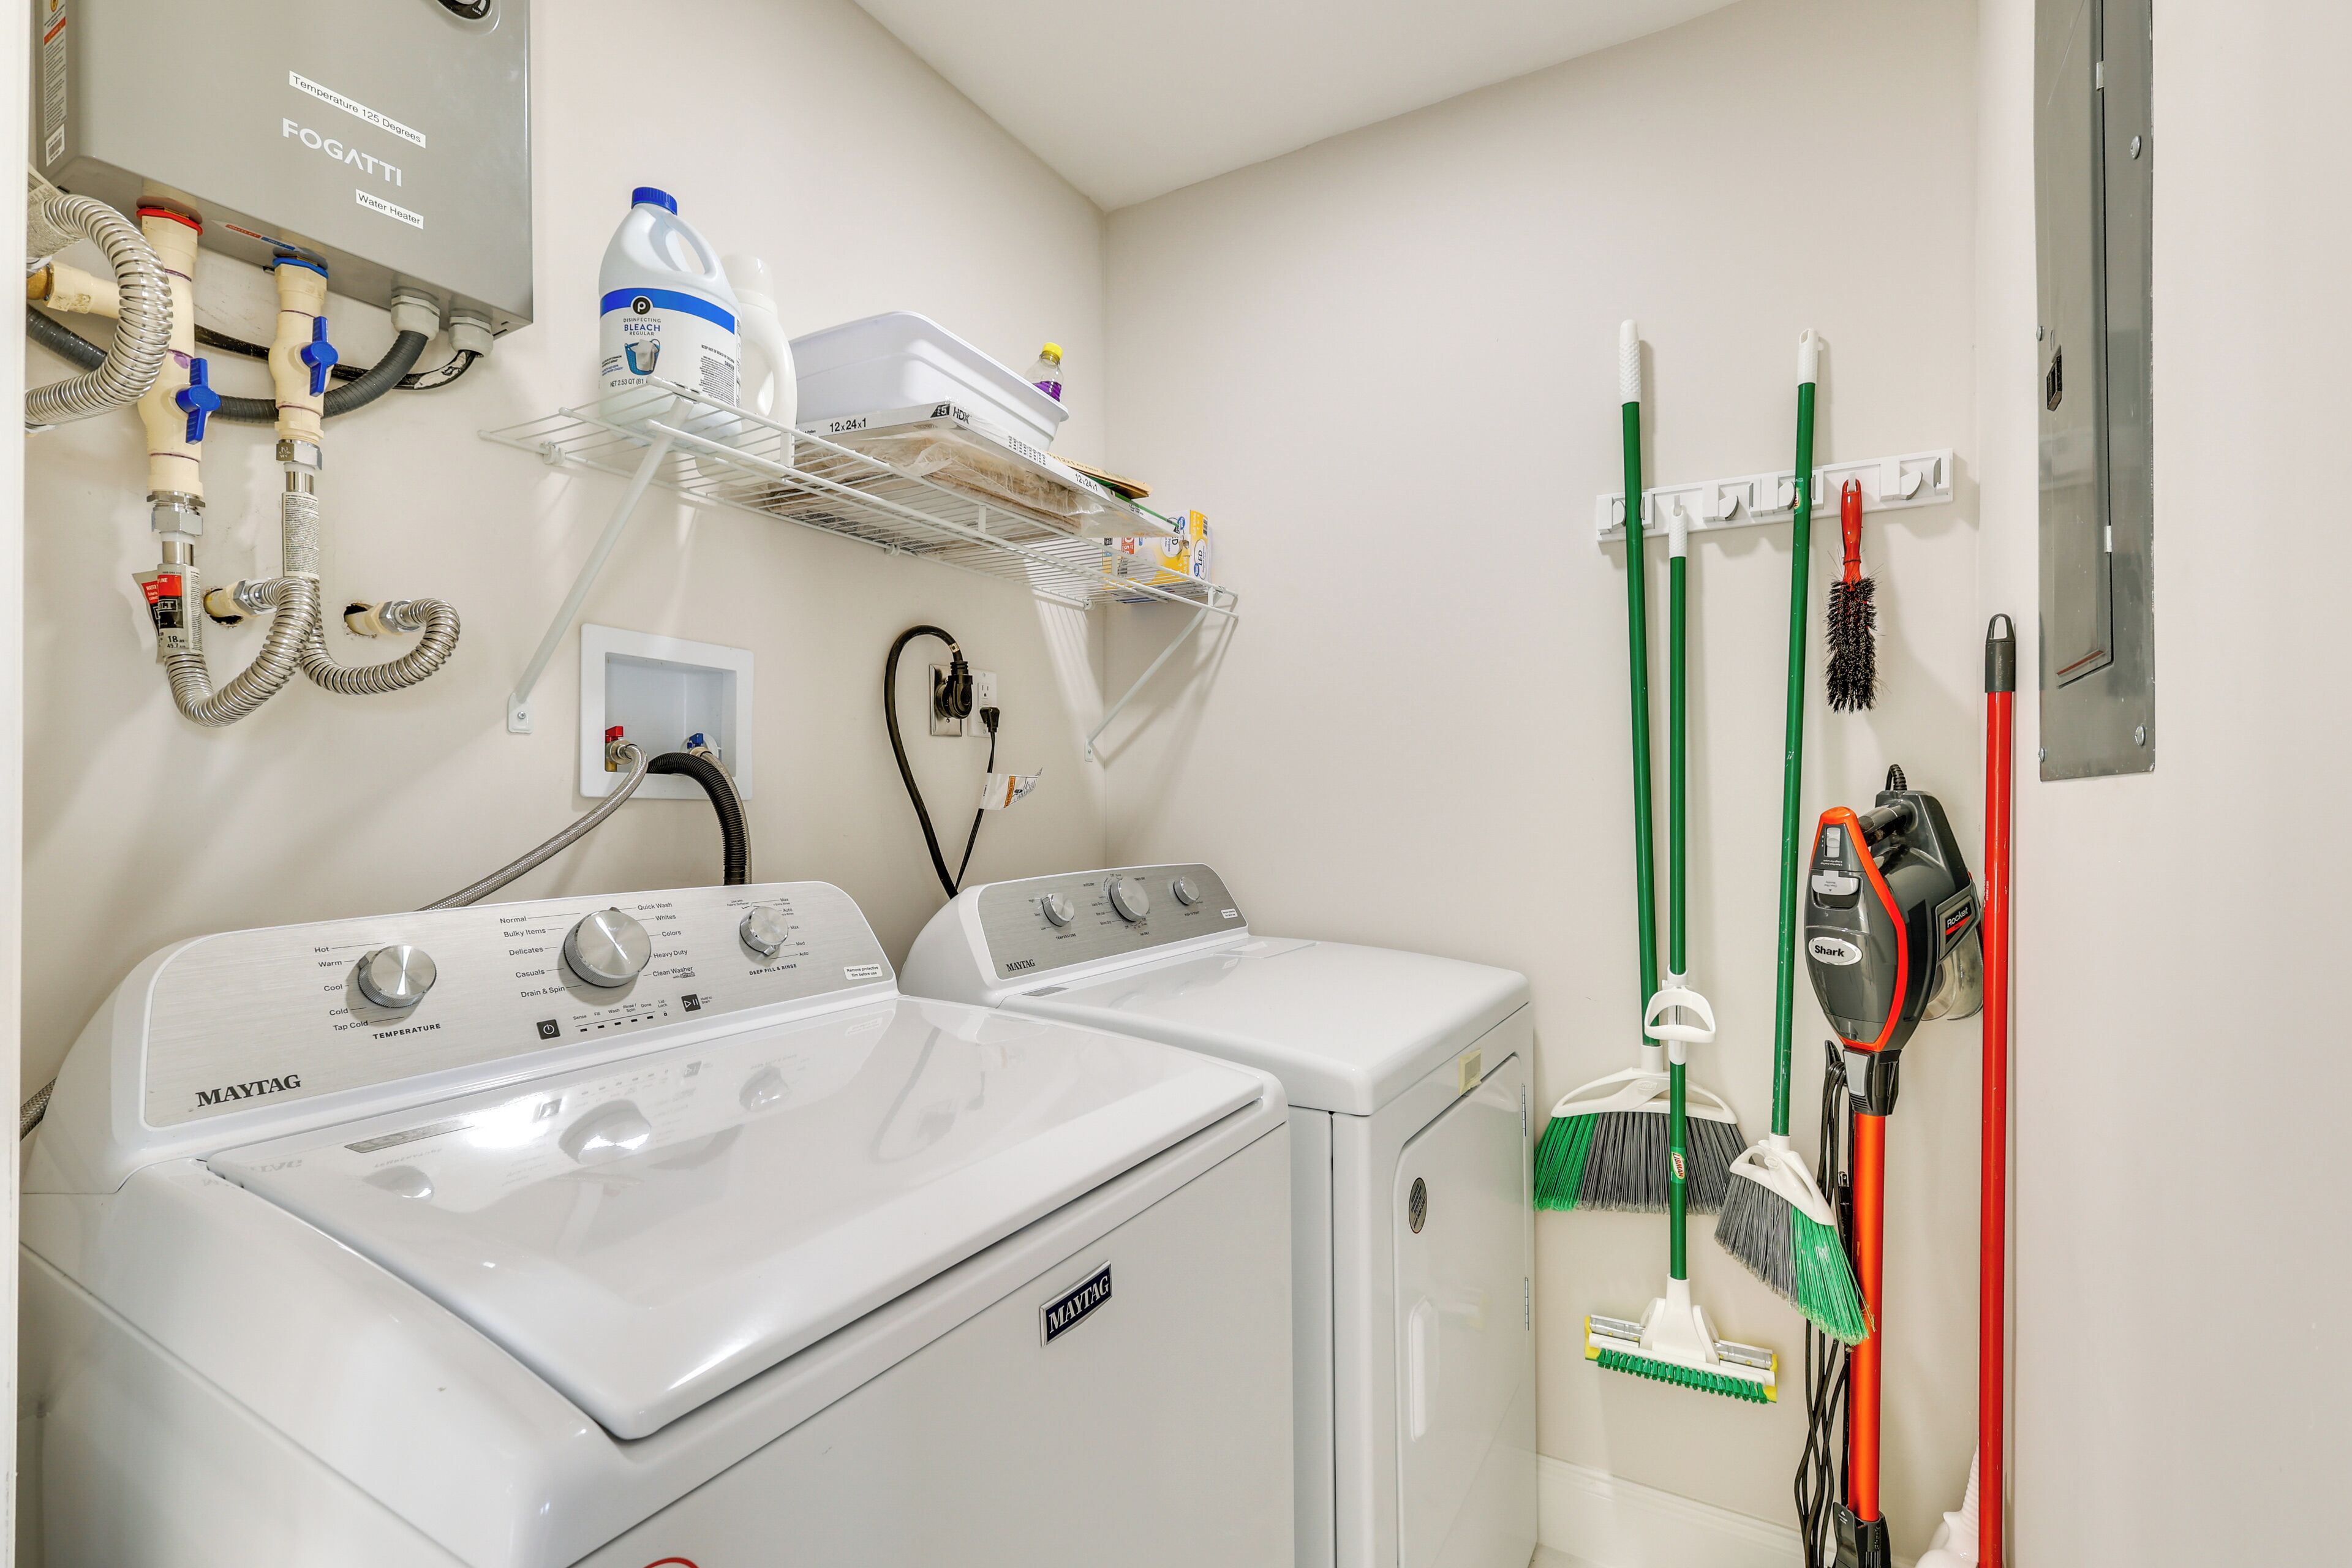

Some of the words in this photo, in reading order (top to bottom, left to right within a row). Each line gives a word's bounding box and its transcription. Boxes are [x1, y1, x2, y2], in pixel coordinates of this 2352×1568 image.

[293, 75, 358, 113] Temperature
[363, 109, 380, 123] 125
[383, 118, 421, 143] Degrees
[282, 118, 402, 187] FOGATTI
[358, 193, 386, 211] Water
[390, 206, 420, 224] Heater
[953, 406, 970, 424] HDX
[829, 418, 867, 432] 12x24x1
[1075, 473, 1098, 492] 12x24x1
[1947, 907, 1969, 928] Rocket
[509, 947, 544, 956] Delicates
[1814, 944, 1845, 958] Shark
[516, 970, 545, 978] Casuals
[1006, 959, 1036, 972] MAYTAG
[372, 1023, 441, 1039] TEMPERATURE
[195, 1074, 301, 1107] MAYTAG
[1673, 1152, 1684, 1177] LIBMAN
[1048, 1276, 1110, 1334] MAYTAG
